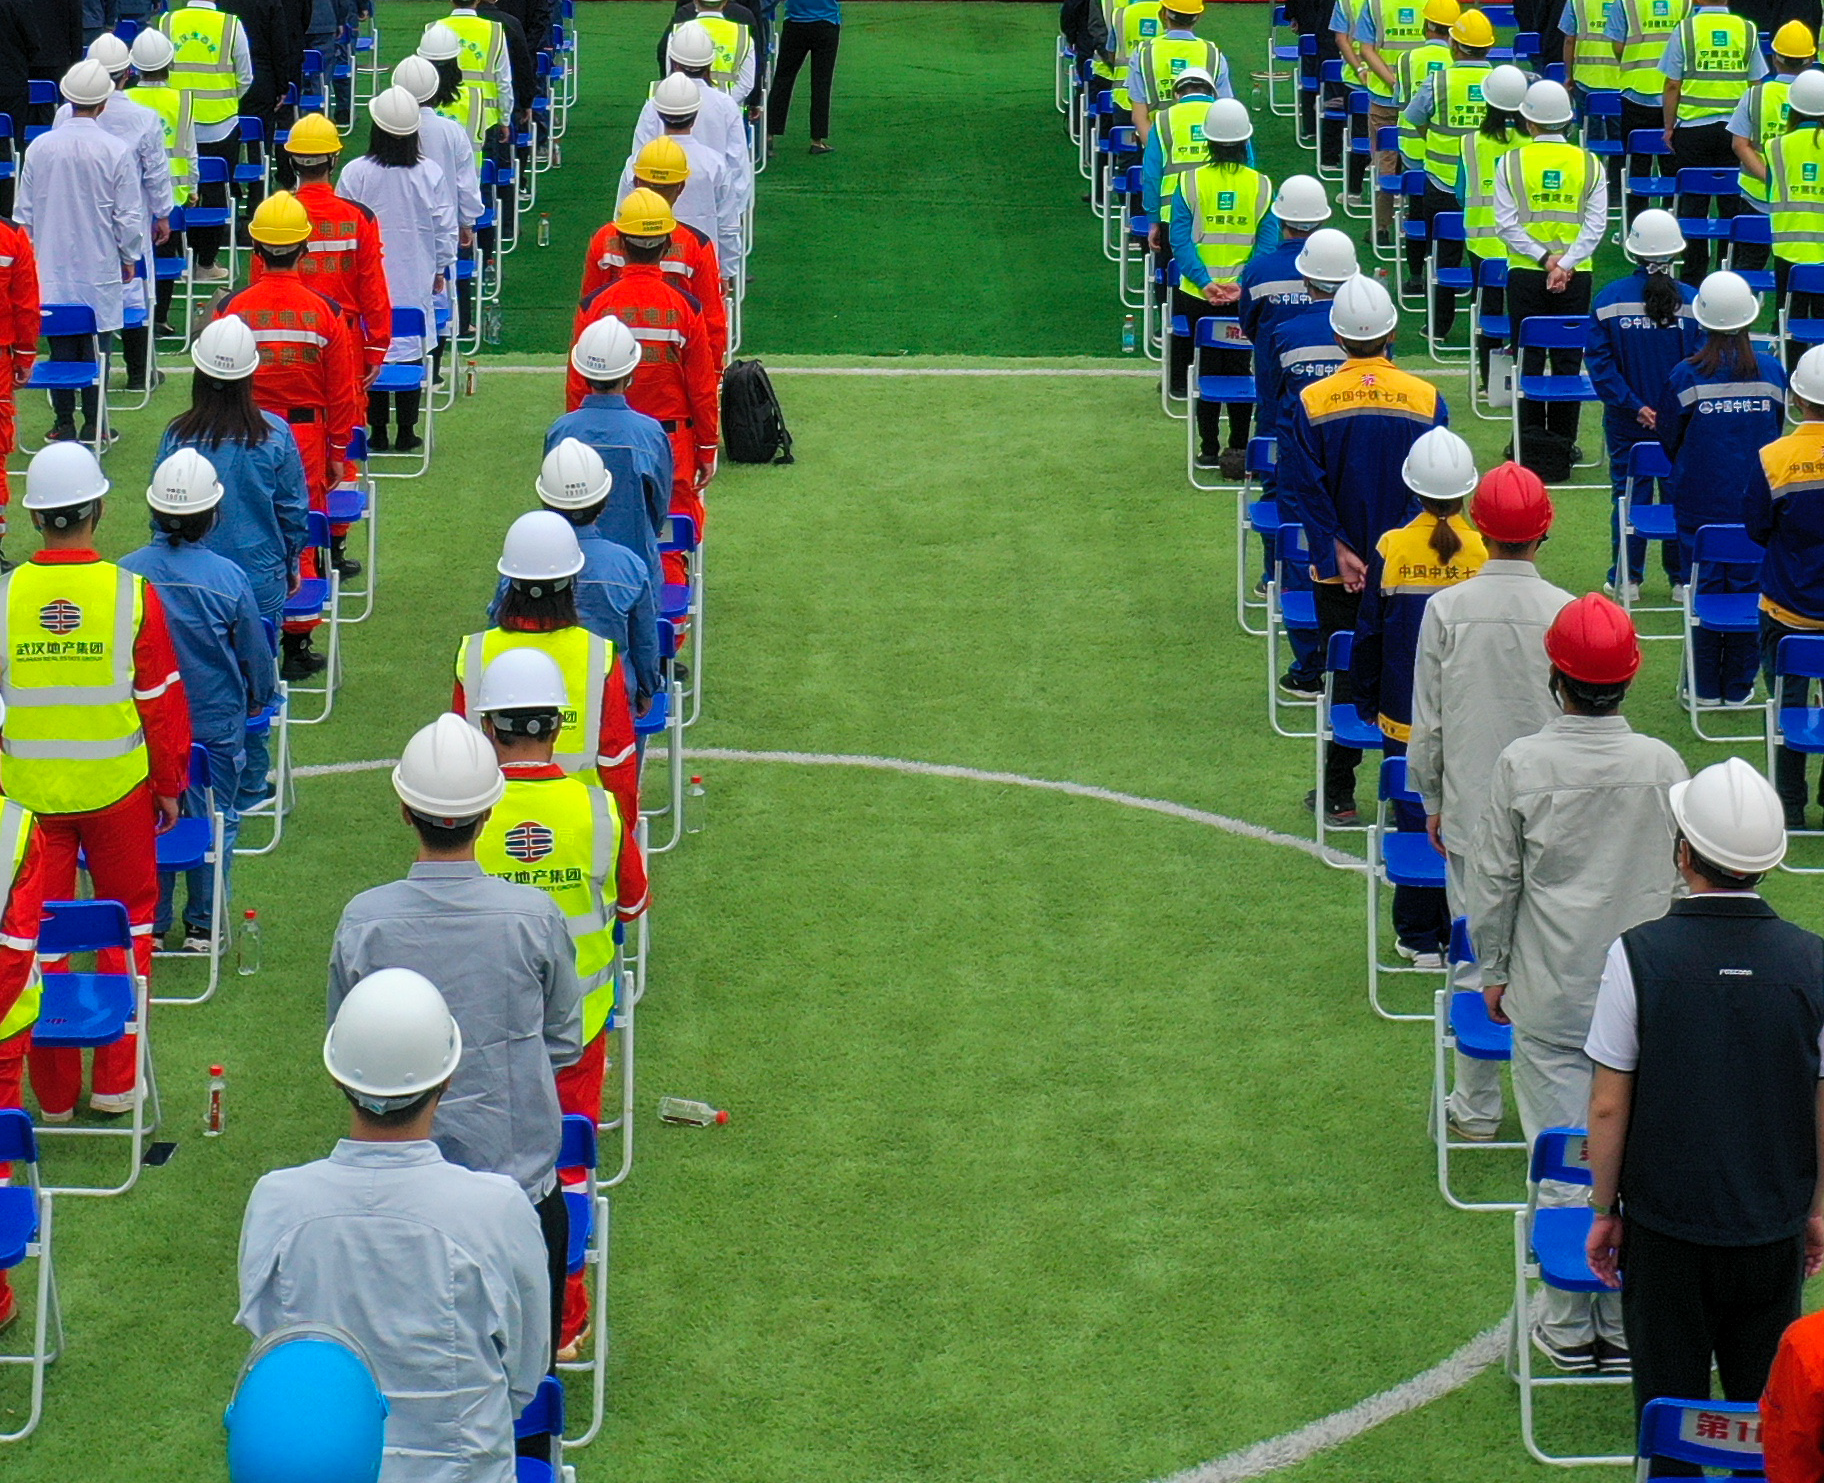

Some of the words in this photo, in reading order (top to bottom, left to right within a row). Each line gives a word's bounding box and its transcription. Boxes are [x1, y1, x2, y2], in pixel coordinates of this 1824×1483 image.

[1329, 390, 1408, 405] 中国中铁七局
[1714, 399, 1771, 413] 中国中铁二局
[15, 641, 104, 655] 武汉地产集团
[484, 867, 581, 885] 汉地产集团
